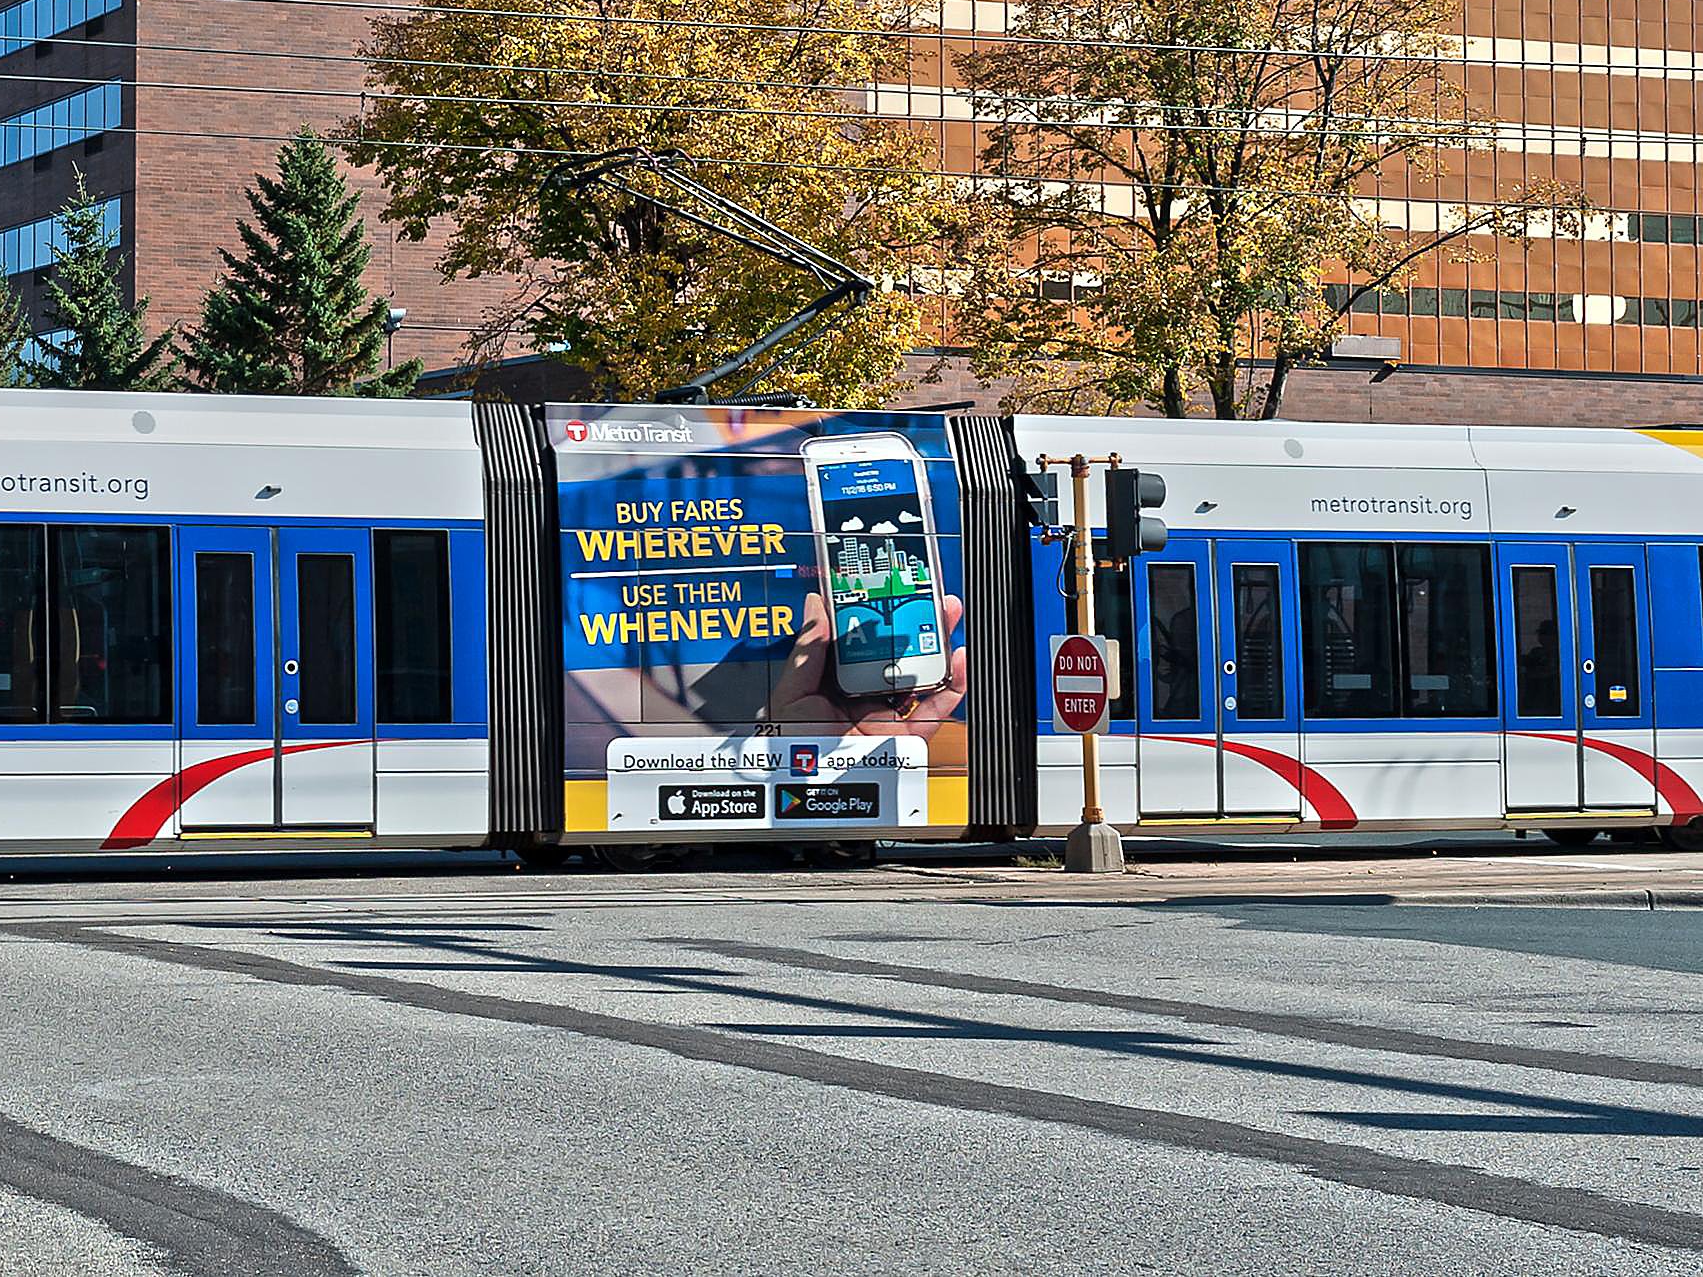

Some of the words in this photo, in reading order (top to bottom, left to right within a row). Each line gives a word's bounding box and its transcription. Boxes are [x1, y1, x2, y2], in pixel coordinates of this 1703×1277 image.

[616, 501, 663, 524] BUY
[671, 498, 744, 523] FARES
[1311, 495, 1473, 520] metrotransit.org
[576, 523, 787, 562] WHEREVER
[622, 584, 667, 608] USE
[674, 581, 742, 604] THEM
[579, 605, 795, 645] WHENEVER
[1059, 656, 1073, 670] DO
[1077, 656, 1098, 671] NOT
[1064, 698, 1097, 714] ENTER
[754, 724, 783, 737] 221
[624, 753, 704, 769] Download
[711, 754, 737, 768] the
[743, 753, 783, 768] NEW
[827, 756, 856, 770] app
[861, 753, 911, 769] today:
[692, 789, 730, 799] Download
[731, 790, 742, 798] on
[743, 789, 757, 798] the
[806, 788, 821, 797] GET
[828, 788, 840, 796] ON
[691, 800, 720, 817] App
[721, 800, 757, 814] Store
[806, 797, 848, 813] Google
[848, 798, 874, 814] Play
